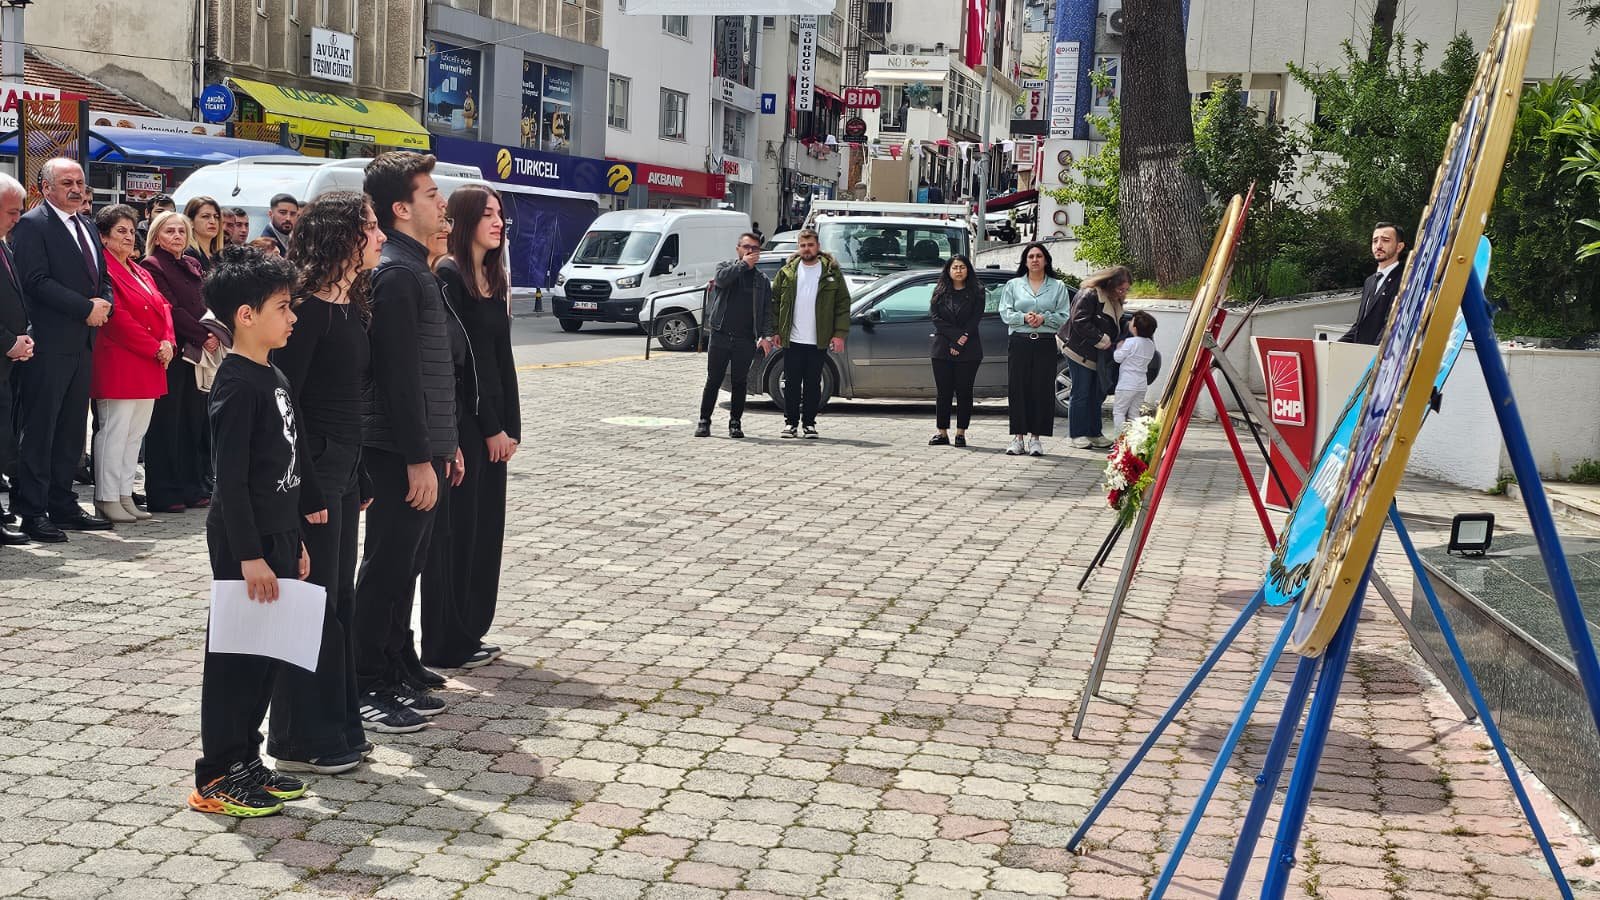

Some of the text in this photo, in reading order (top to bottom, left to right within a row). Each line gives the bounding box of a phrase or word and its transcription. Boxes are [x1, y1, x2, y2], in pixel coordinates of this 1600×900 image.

[315, 43, 351, 61] AVUKAT
[313, 58, 352, 79] YEŞİM GÜNER
[800, 76, 809, 109] KURSU
[848, 89, 877, 106] BİM
[1018, 145, 1031, 161] E
[514, 157, 560, 180] TURKCELL
[647, 172, 684, 188] AKBANK
[1274, 398, 1302, 418] CHP
